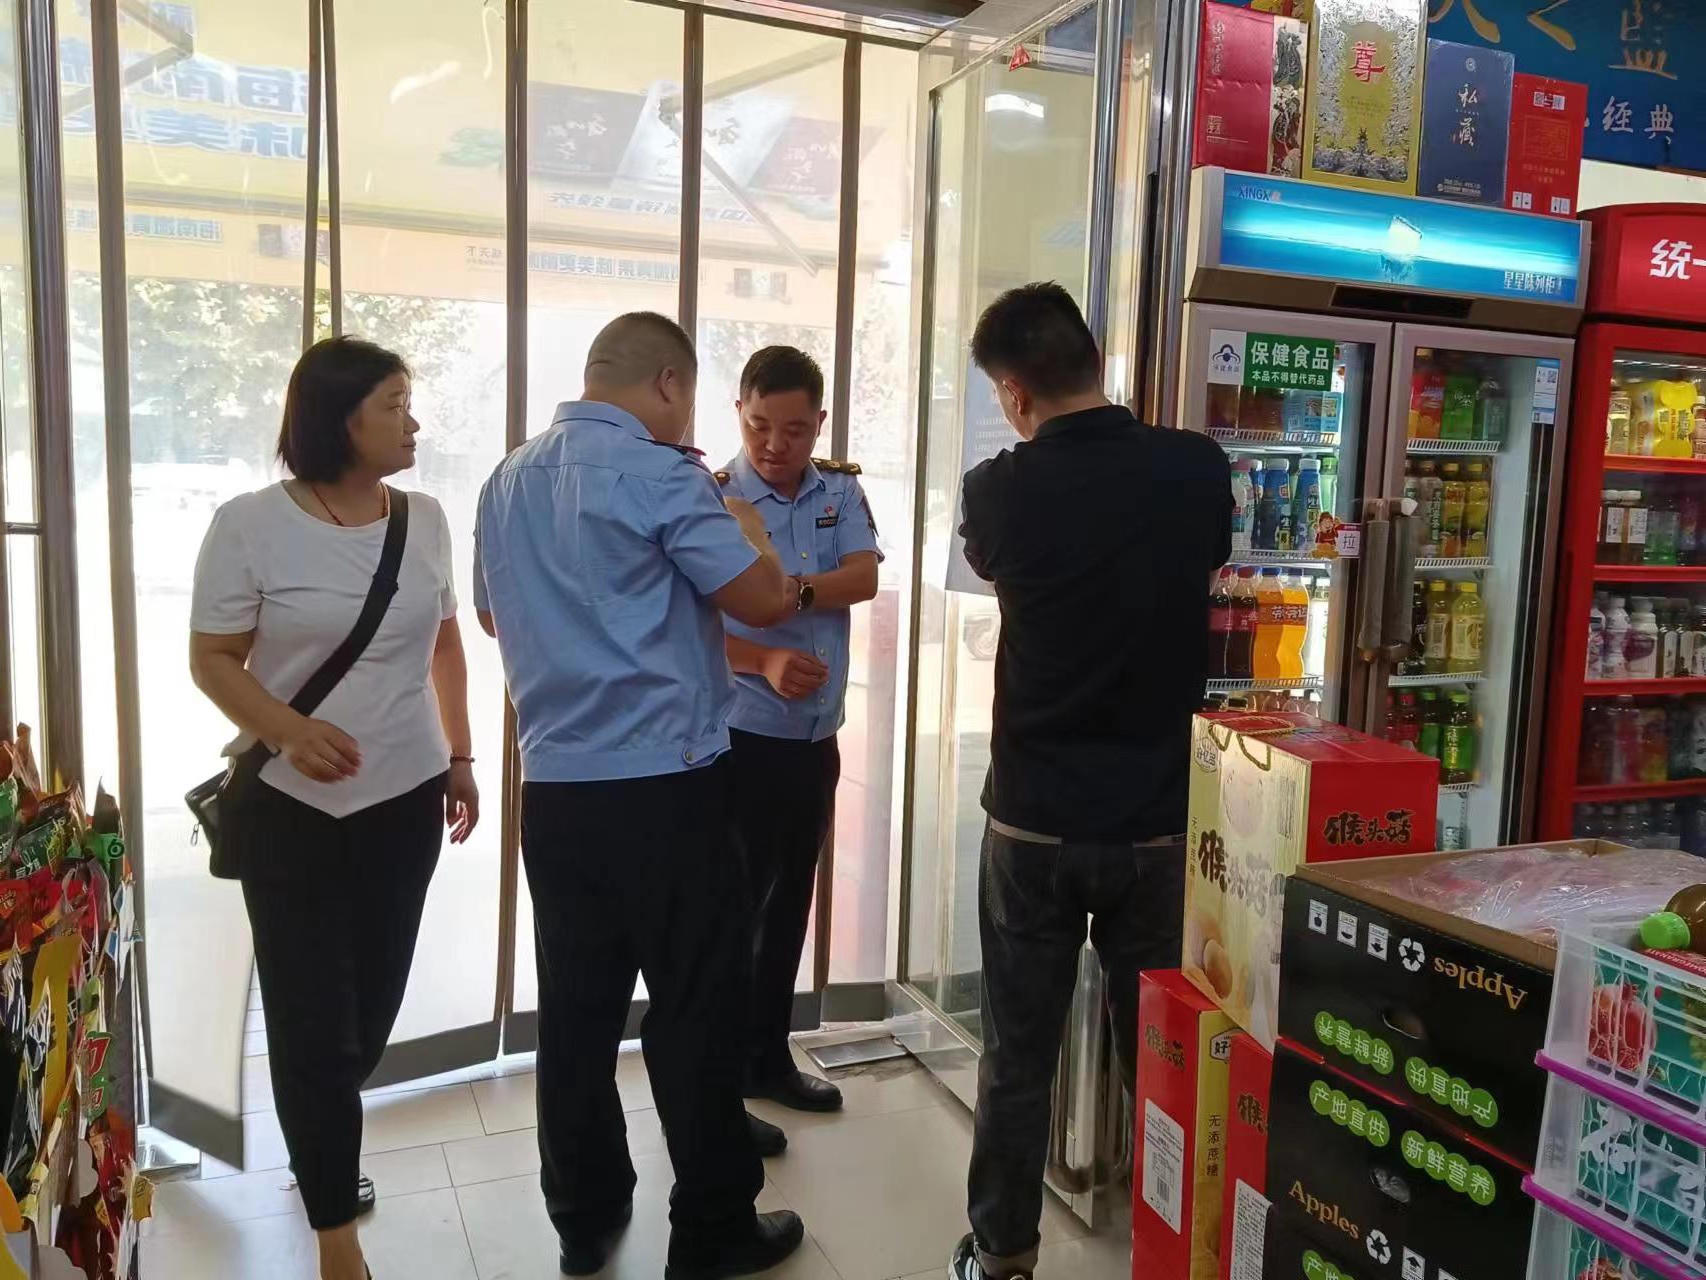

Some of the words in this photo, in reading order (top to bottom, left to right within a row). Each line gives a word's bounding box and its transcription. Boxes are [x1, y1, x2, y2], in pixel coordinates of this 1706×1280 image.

[1350, 41, 1385, 82] 尊
[1602, 95, 1675, 145] 经典
[1250, 341, 1329, 370] 保健食品
[1251, 370, 1326, 386] 本品不得替代药品
[1343, 533, 1357, 550] 拉
[1322, 807, 1416, 846] 猴头菇
[1433, 957, 1528, 1011] Apples
[1213, 1040, 1231, 1055] 好
[1317, 1015, 1391, 1070] 新鲜营养
[1409, 1060, 1494, 1121] 产地直供
[1237, 1093, 1271, 1134] 猴
[1313, 1086, 1386, 1144] 产地直供
[1405, 1135, 1491, 1199] 新鲜营养
[1288, 1179, 1361, 1240] Apples
